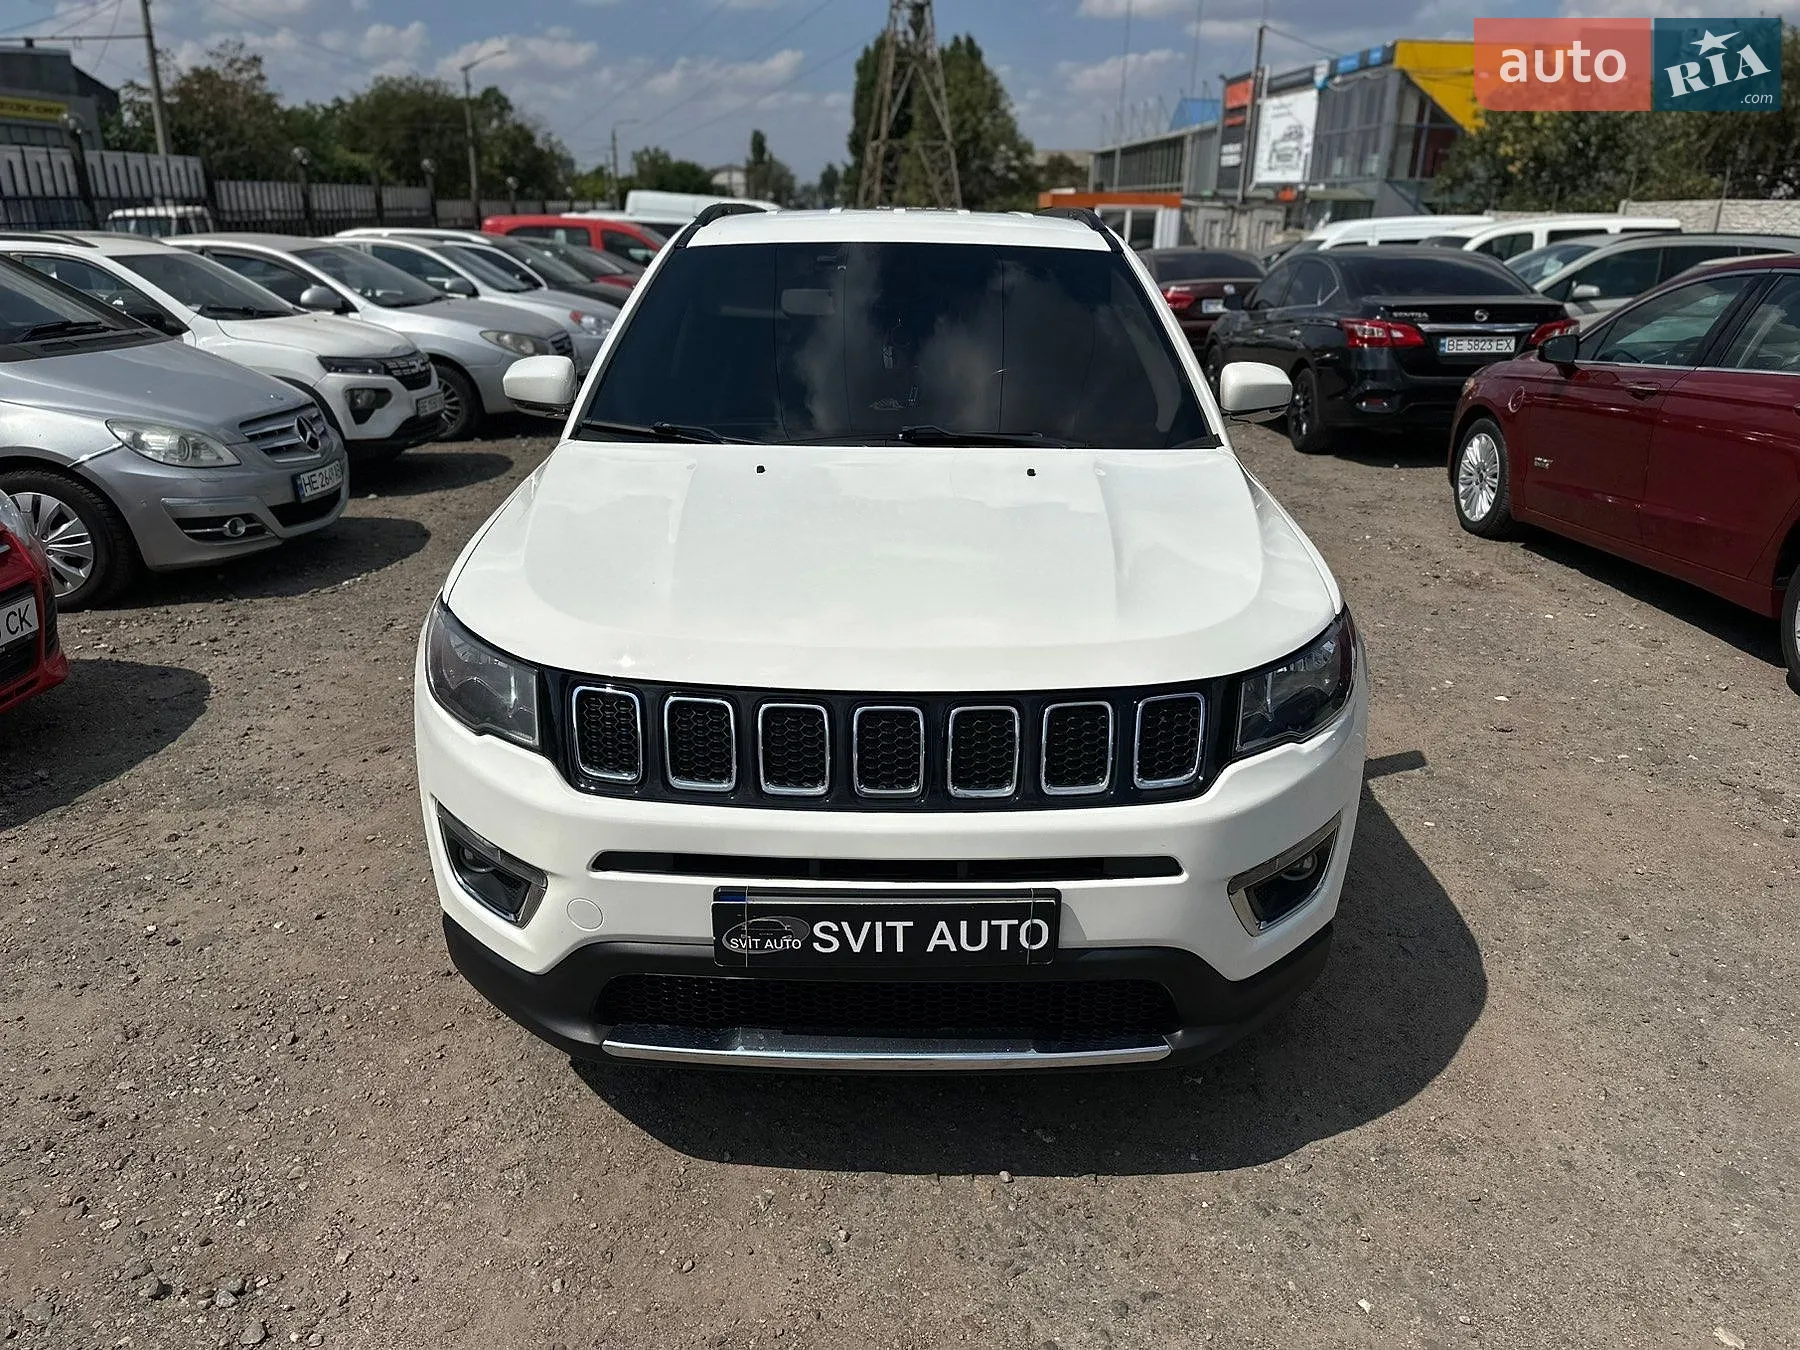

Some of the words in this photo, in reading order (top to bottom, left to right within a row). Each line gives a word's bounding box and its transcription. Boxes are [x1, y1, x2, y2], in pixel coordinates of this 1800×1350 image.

[1447, 339, 1463, 351] BE
[1467, 338, 1493, 351] 5823
[1495, 337, 1512, 351] EX
[302, 474, 319, 493] HE
[6, 604, 32, 635] CK
[730, 938, 760, 950] SVIT
[764, 938, 802, 950] AUTO
[812, 920, 913, 953] SVIT
[926, 919, 1050, 952] AUTO
